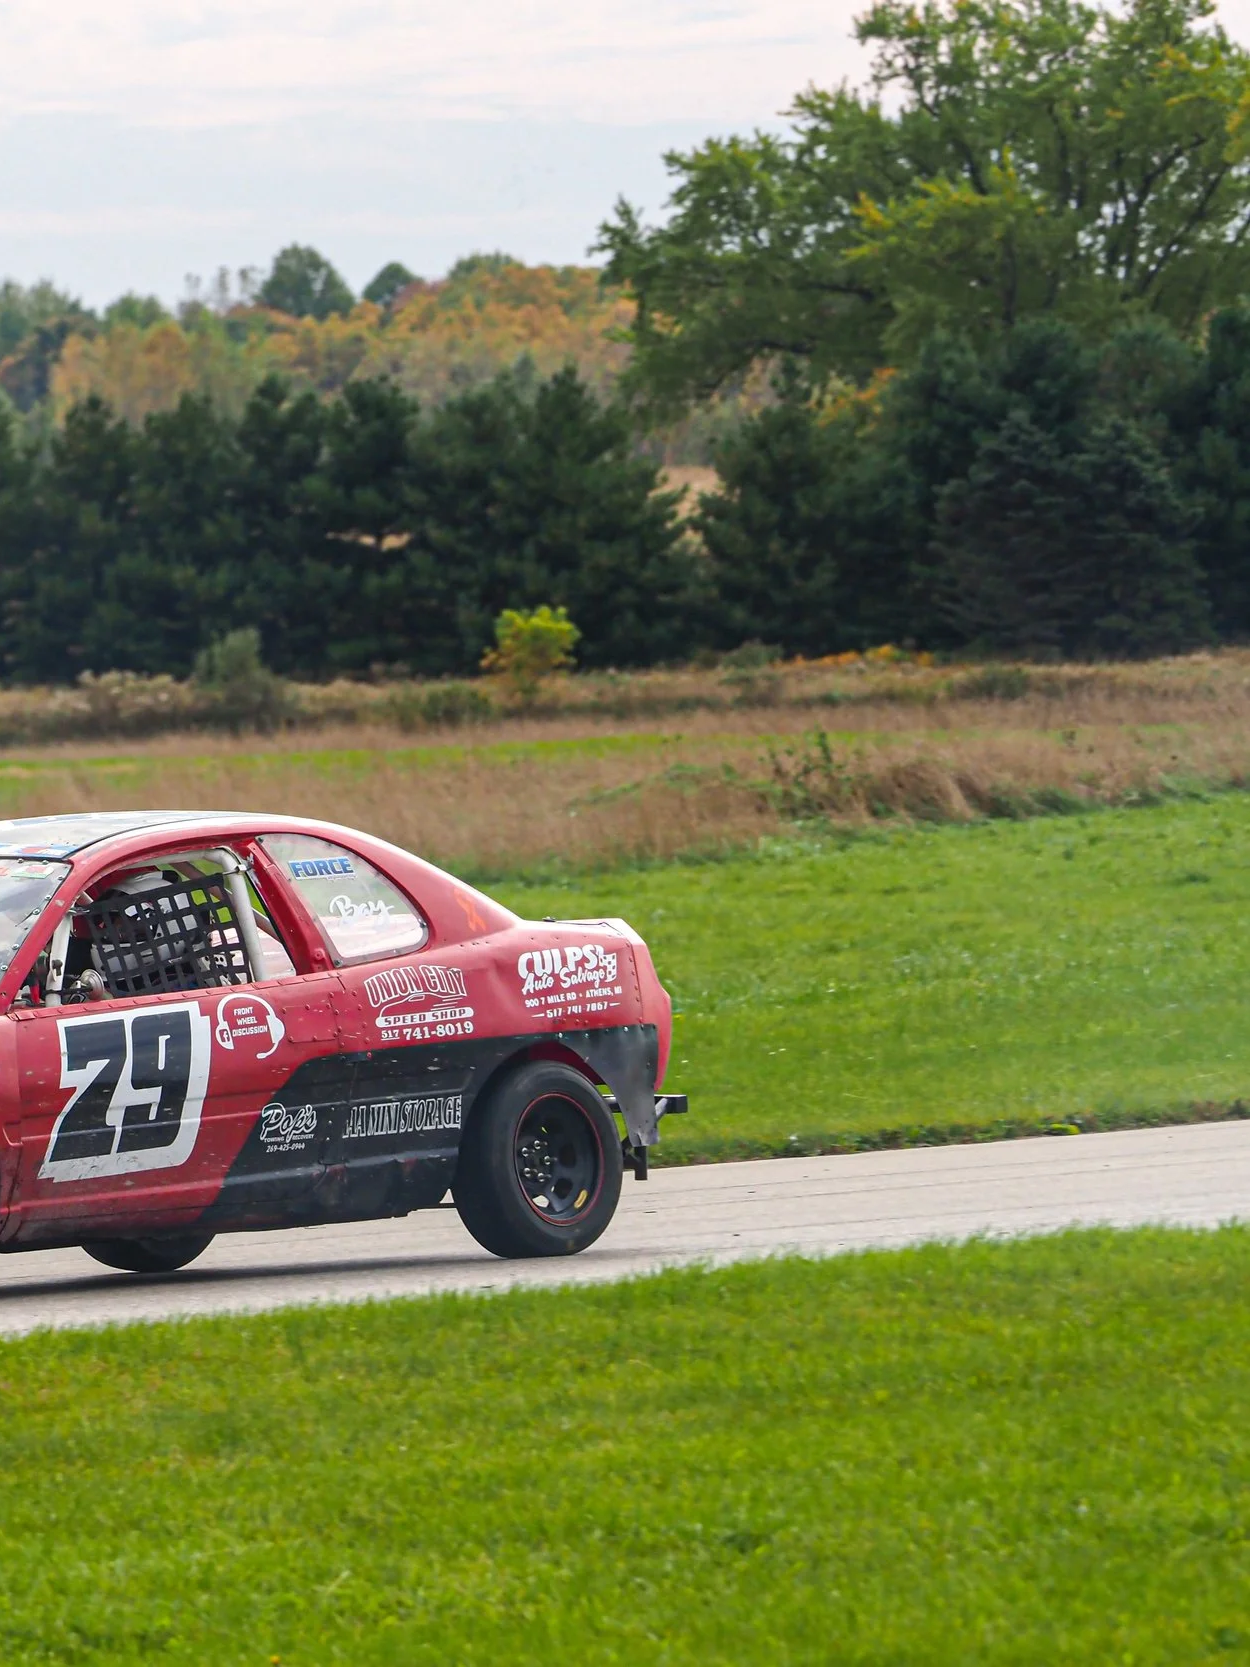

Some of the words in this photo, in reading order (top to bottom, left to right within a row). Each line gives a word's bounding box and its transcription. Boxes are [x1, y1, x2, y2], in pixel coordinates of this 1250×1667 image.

[290, 858, 354, 878] FORCE
[364, 966, 423, 1008] UNION
[419, 965, 467, 996] CITY
[522, 972, 554, 995] Auto
[560, 967, 605, 989] Salvage
[525, 998, 540, 1008] 900
[547, 993, 566, 1004] MILE
[566, 991, 577, 1001] RD
[614, 986, 623, 994] MI
[234, 1007, 253, 1016] FRONT
[237, 1016, 257, 1025] WHEEL
[384, 1014, 427, 1026] SPEED
[432, 1008, 466, 1020] SHOP
[232, 1025, 268, 1037] DISCUSSION
[381, 1029, 400, 1040] 517
[403, 1021, 474, 1040] 741-8019
[41, 1004, 203, 1173] 79
[260, 1103, 317, 1143] Pop's
[399, 1095, 462, 1133] STORAGE
